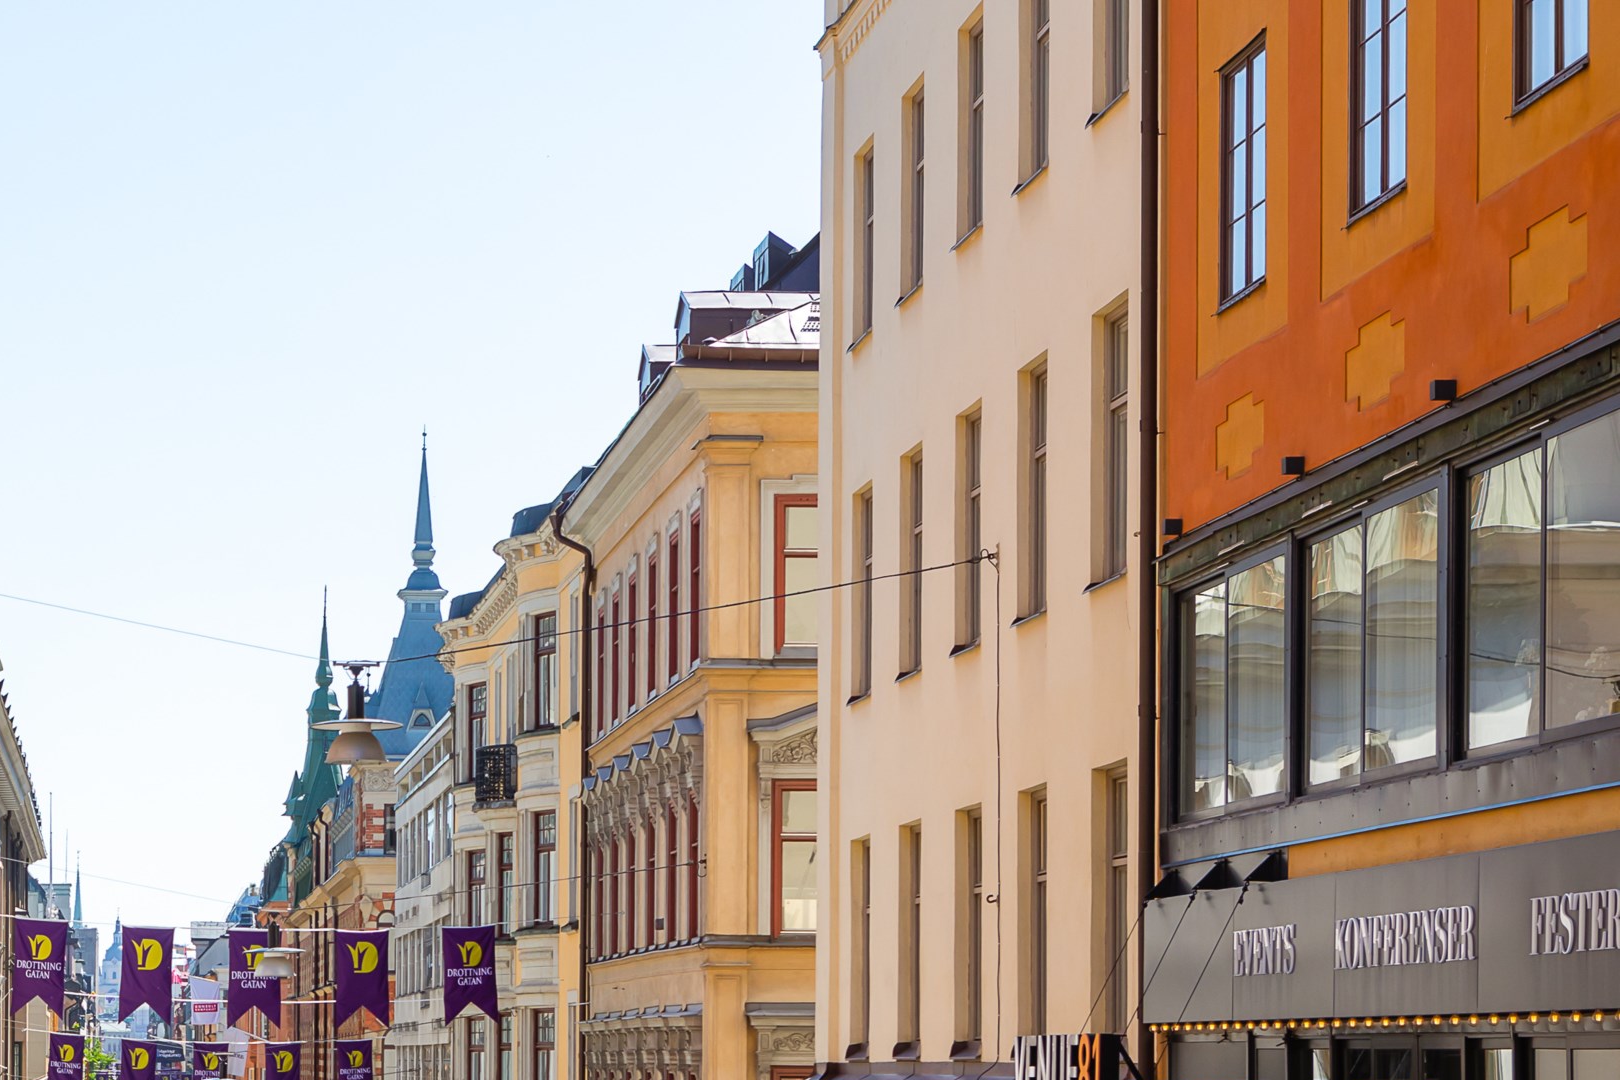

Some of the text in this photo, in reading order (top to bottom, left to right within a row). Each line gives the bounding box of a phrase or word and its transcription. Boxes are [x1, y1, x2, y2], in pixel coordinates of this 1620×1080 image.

[1333, 905, 1477, 970] KONFERENSER
[1232, 923, 1297, 977] EVENTS
[16, 959, 62, 972] DROTTNING
[25, 969, 51, 980] GATAN
[447, 966, 493, 978] DROTTNING
[241, 979, 267, 990] GATAN
[457, 975, 483, 987] GATAN
[50, 1060, 81, 1070] DROTTNING
[56, 1067, 74, 1075] GATAN
[339, 1067, 371, 1076] DROTTNING
[346, 1073, 364, 1080] GATAN
